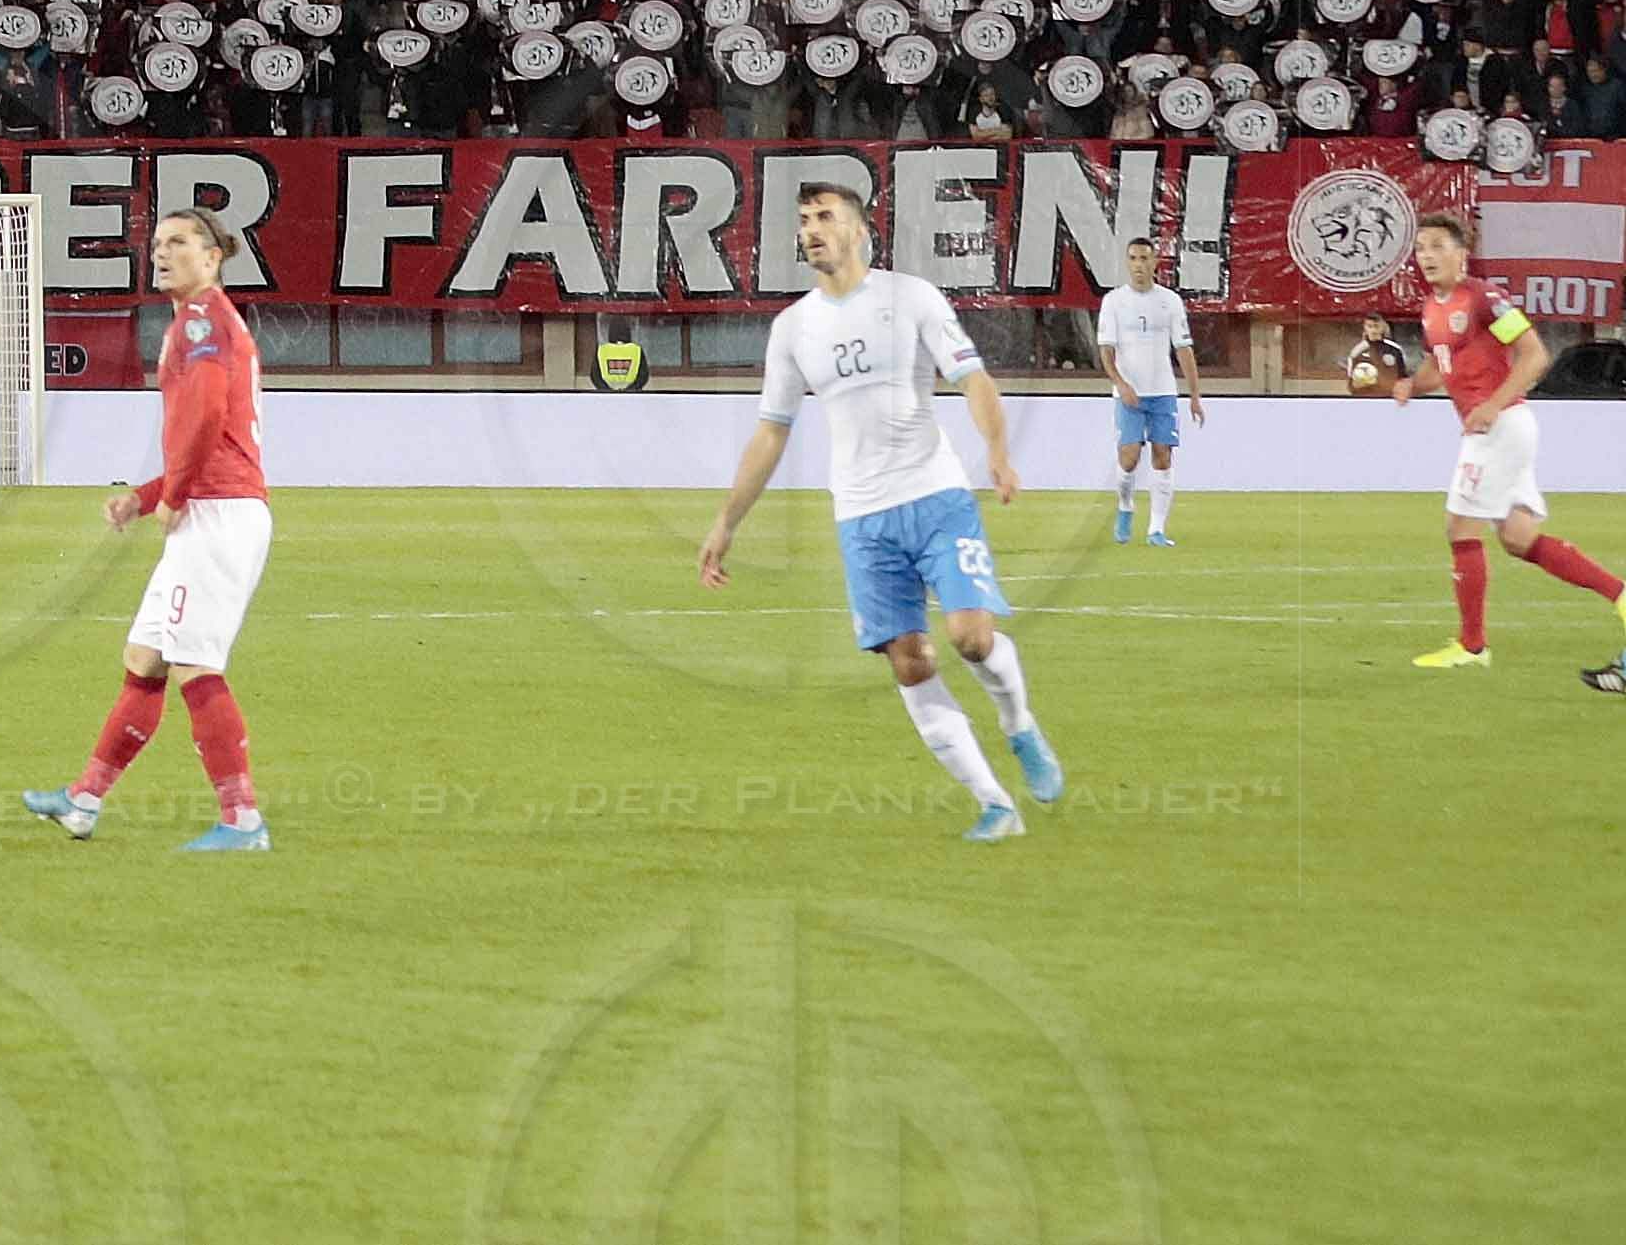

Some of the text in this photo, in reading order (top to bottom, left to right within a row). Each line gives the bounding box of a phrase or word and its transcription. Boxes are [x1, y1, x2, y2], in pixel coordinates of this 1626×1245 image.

[336, 146, 1236, 298] FARBEN!
[833, 339, 872, 378] 22
[169, 584, 187, 624] 9
